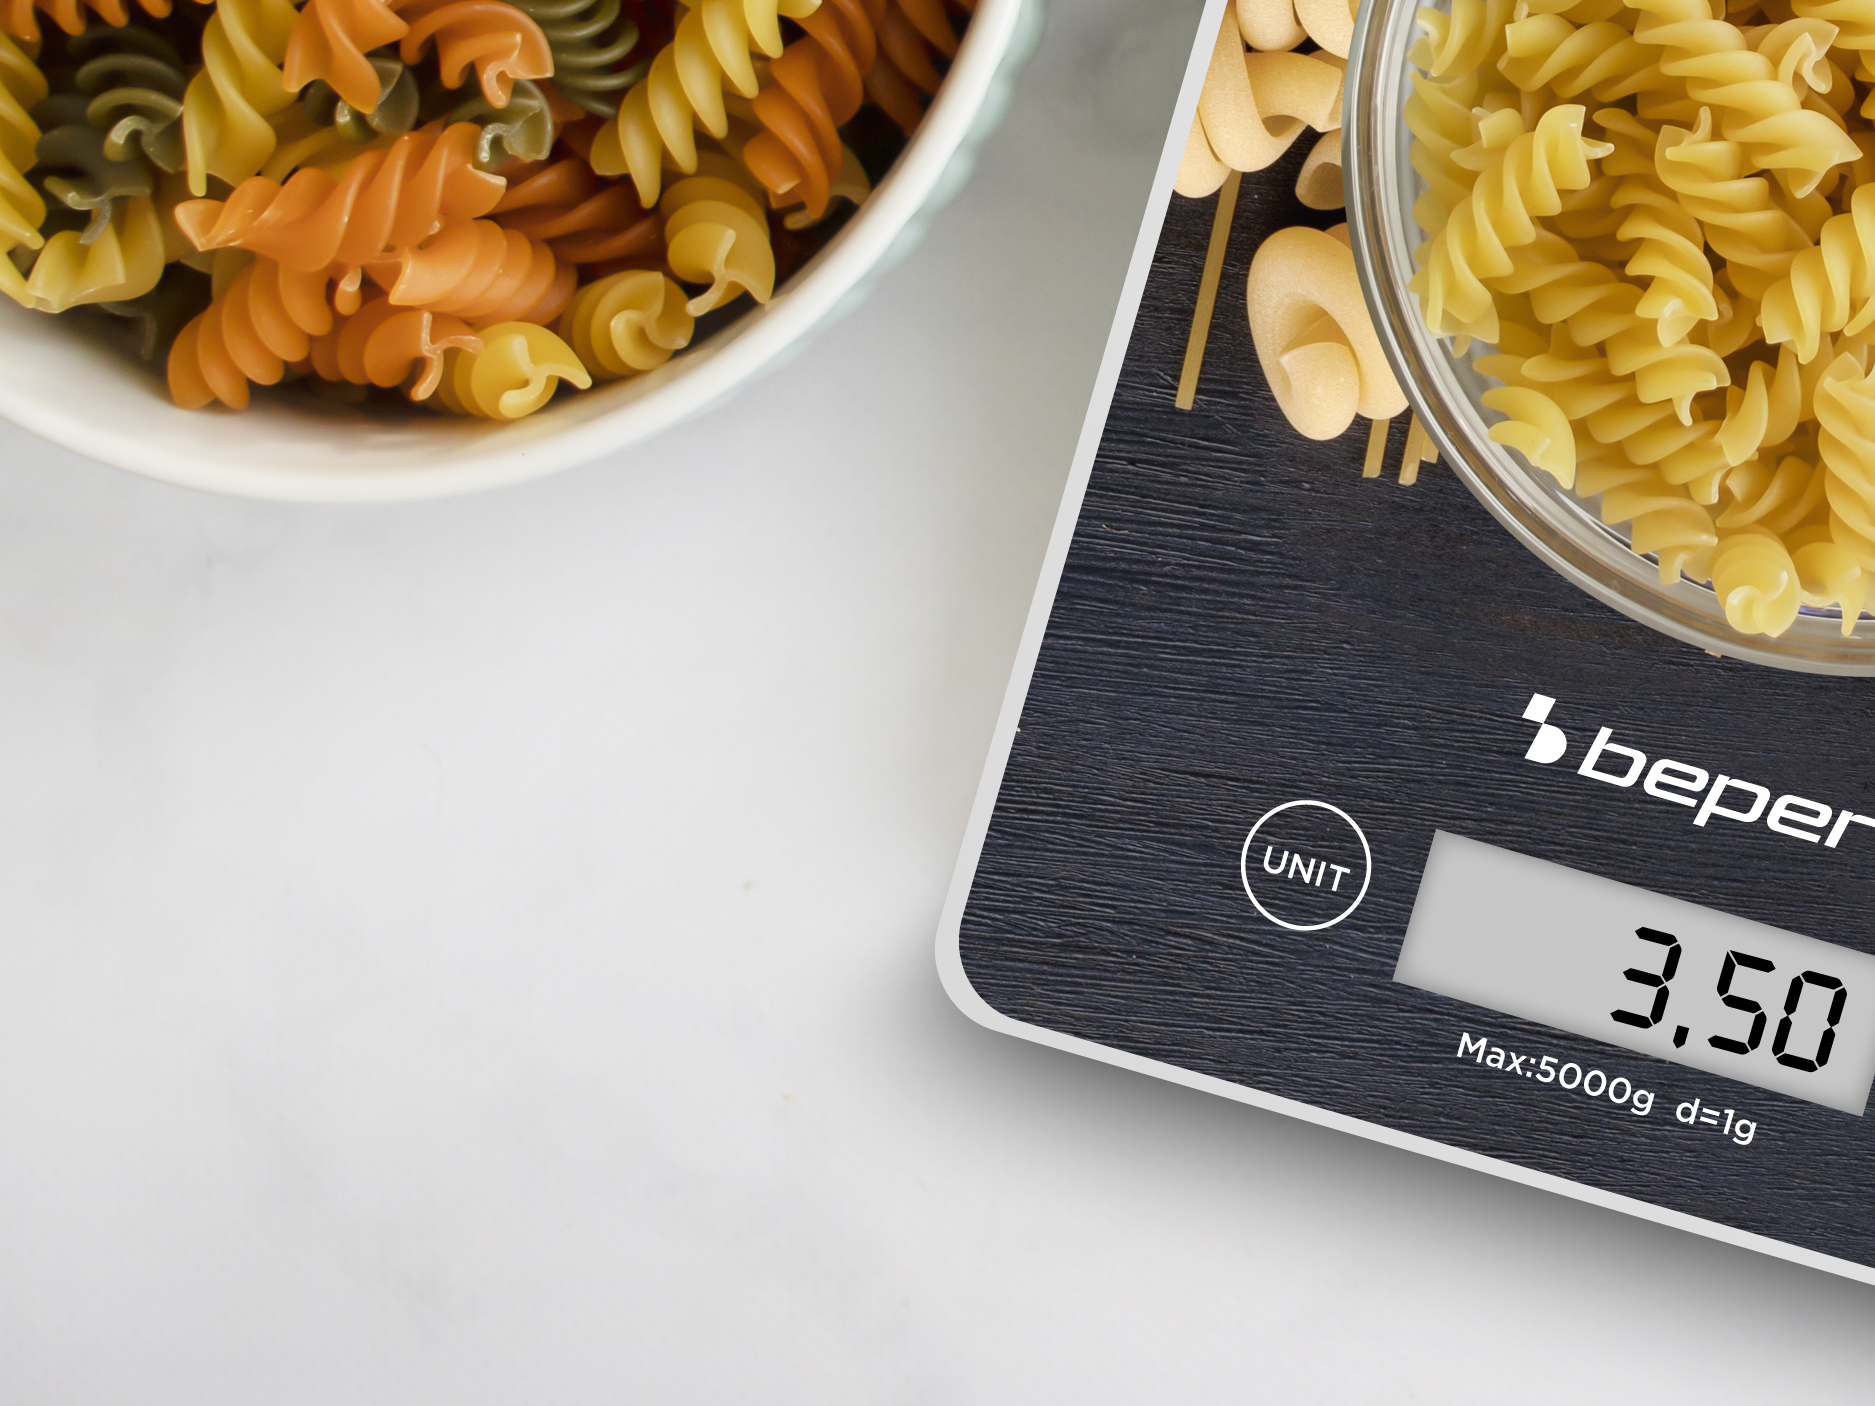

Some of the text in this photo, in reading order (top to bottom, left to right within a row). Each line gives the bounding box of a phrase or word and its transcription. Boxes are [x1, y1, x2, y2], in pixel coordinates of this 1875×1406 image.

[1262, 845, 1351, 893] UNIT
[1456, 1031, 1758, 1146] Max:5000g d=1g
